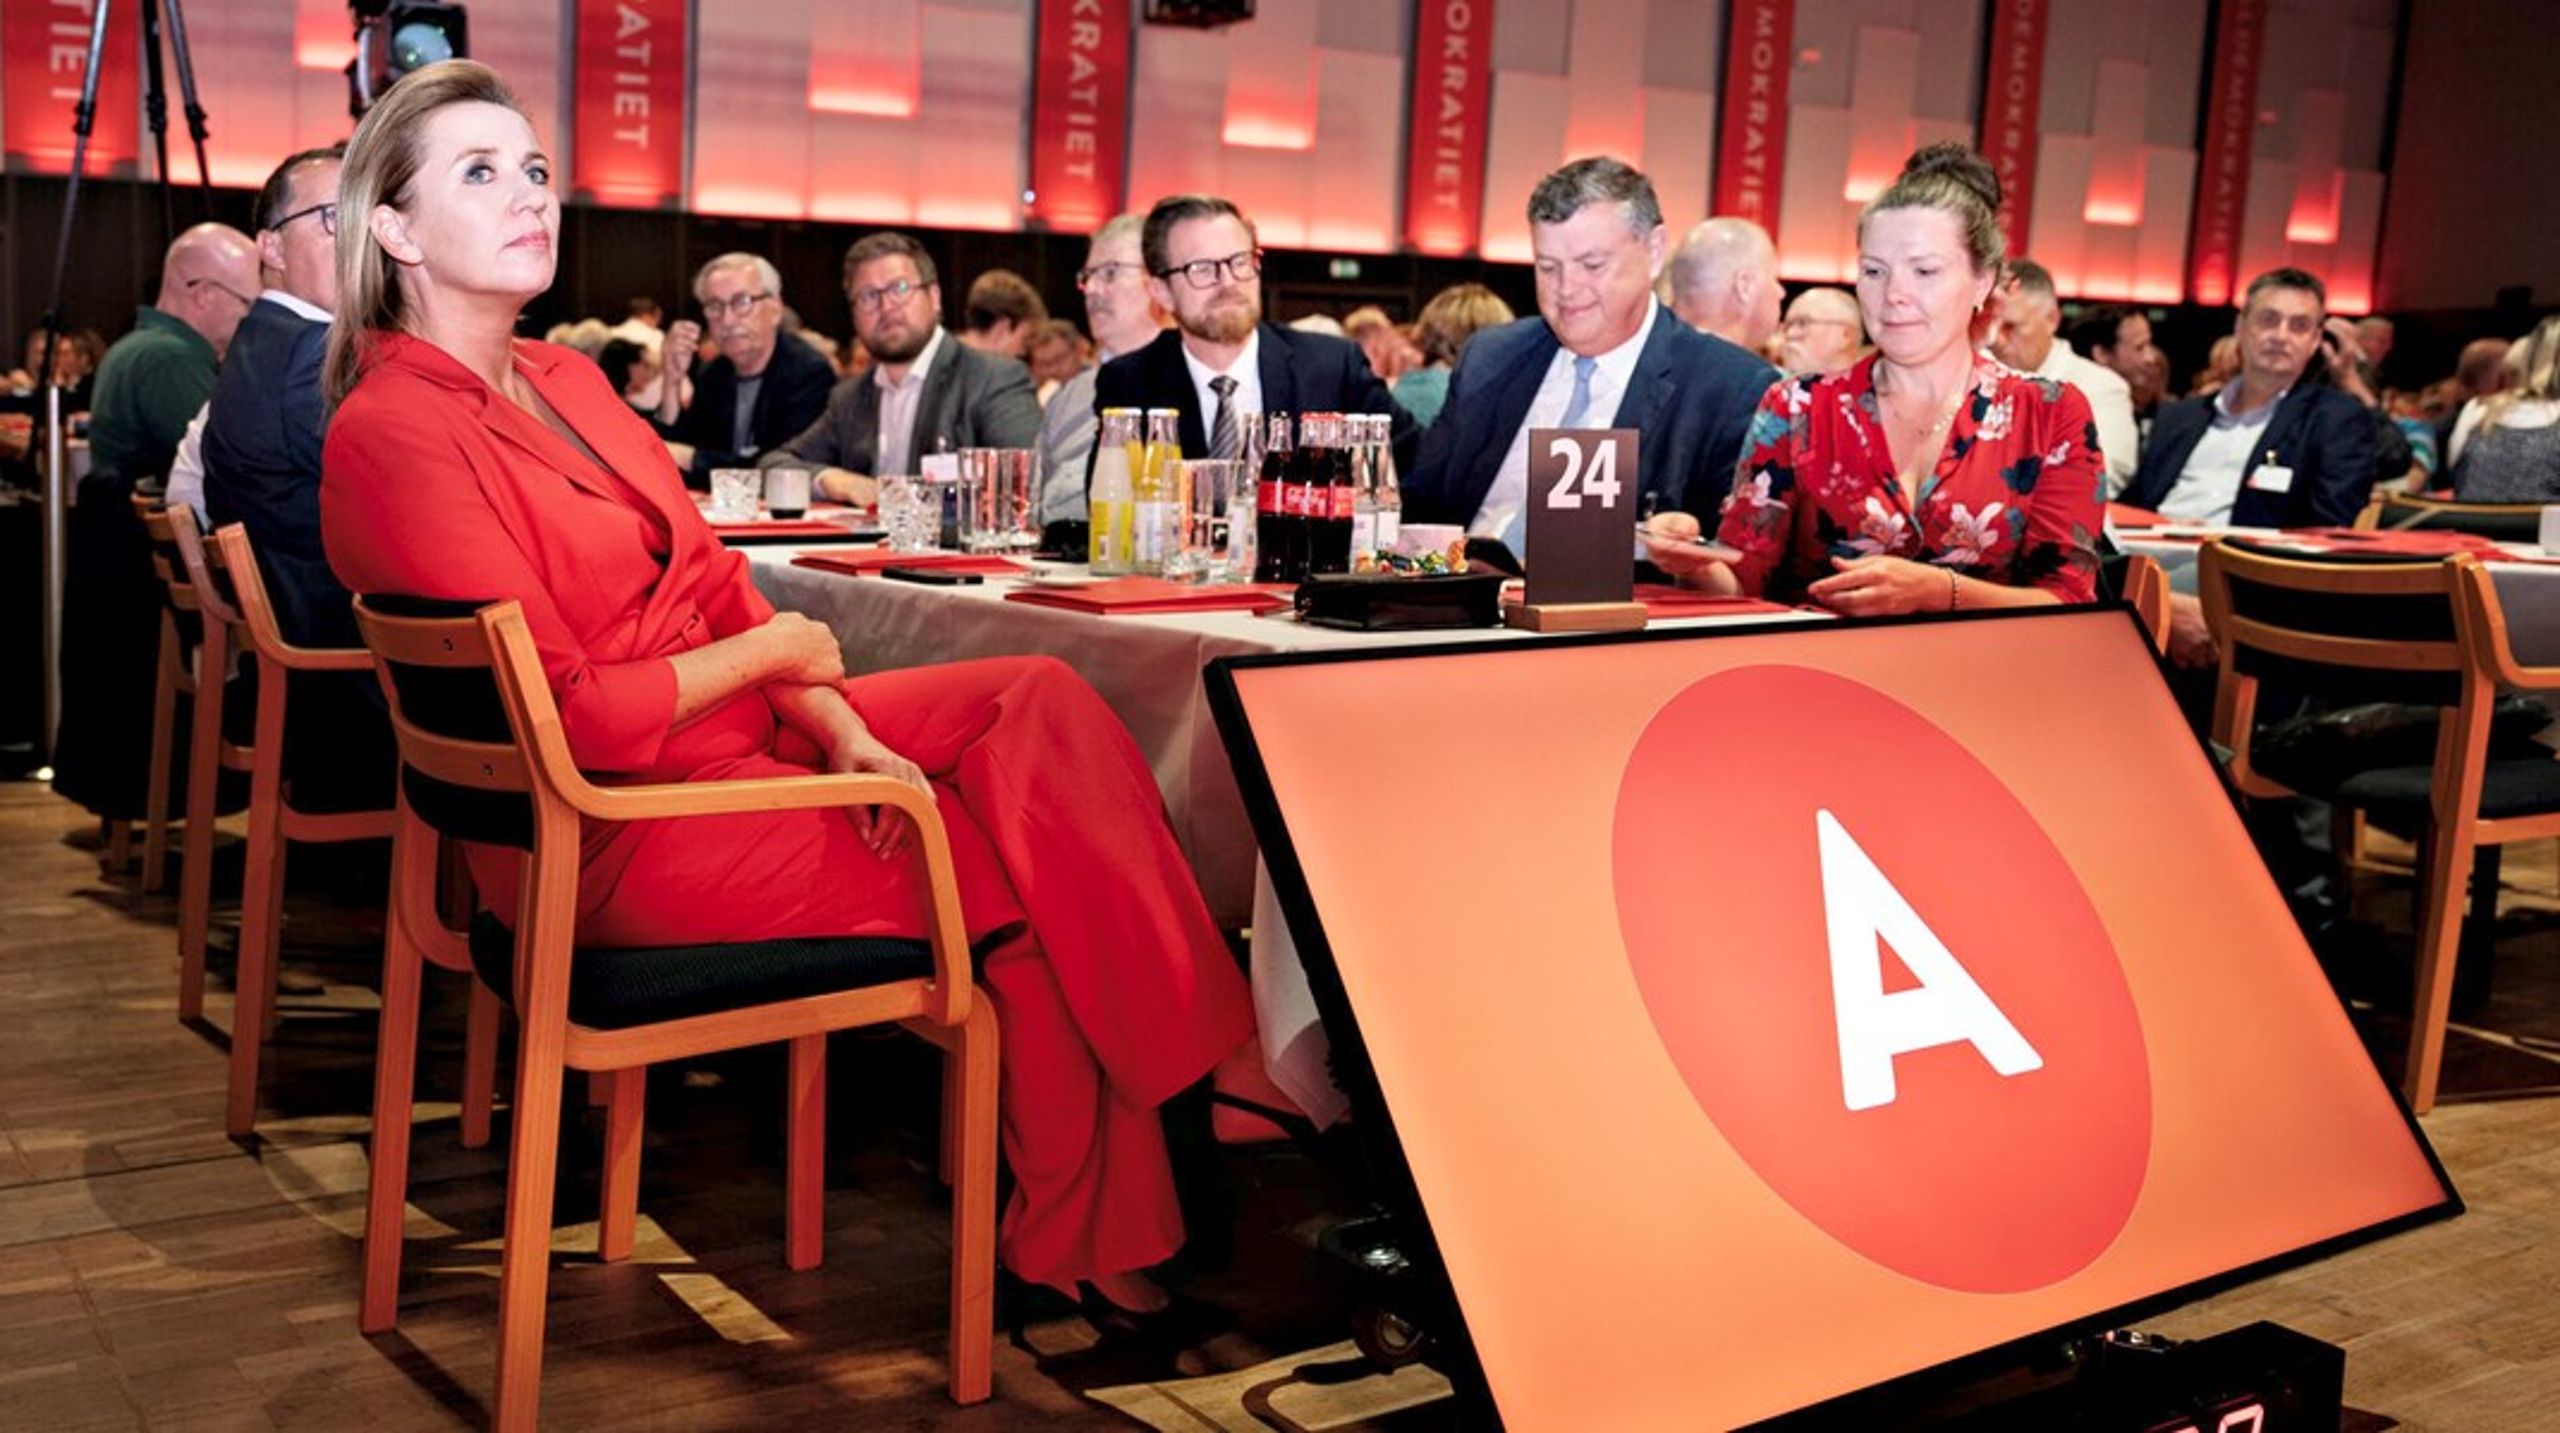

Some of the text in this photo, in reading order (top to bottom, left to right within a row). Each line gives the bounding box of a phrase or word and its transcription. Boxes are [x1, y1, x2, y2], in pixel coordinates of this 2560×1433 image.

[615, 0, 651, 150] ATIET
[1066, 0, 1101, 182] KRATIET
[1434, 1, 1471, 209] OKRATIET
[1738, 7, 1774, 226] MOKRATIE
[1547, 437, 1621, 508] 24
[1815, 808, 2044, 1112] A
